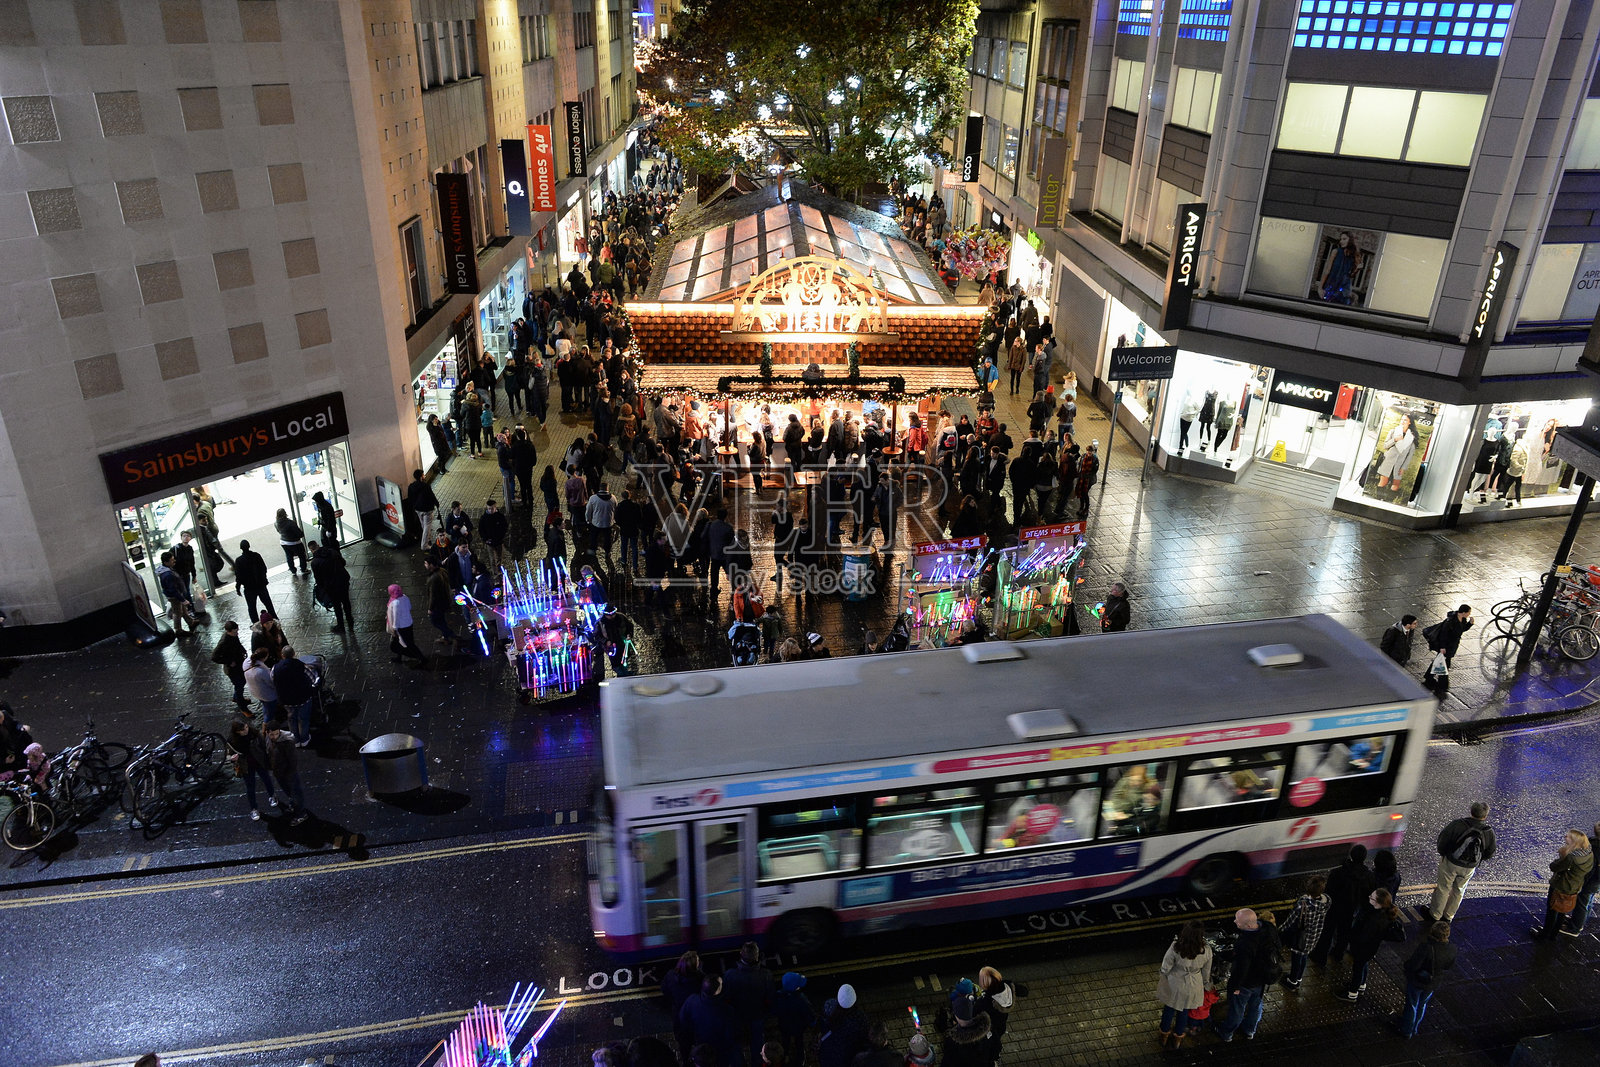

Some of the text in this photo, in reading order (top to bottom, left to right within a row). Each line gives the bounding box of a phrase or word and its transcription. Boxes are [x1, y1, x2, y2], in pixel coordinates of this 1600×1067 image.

[571, 105, 583, 175] vision express
[537, 158, 553, 208] phones
[963, 155, 973, 182] ecco
[1040, 174, 1061, 225] hotter
[449, 181, 462, 253] Sainsbury's
[1177, 210, 1200, 287] APRICOT
[455, 253, 470, 288] Local
[1475, 251, 1504, 338] APRICOT
[1117, 354, 1172, 365] Welcome
[1275, 381, 1333, 402] APRICOT
[123, 426, 270, 484] Sainsbury's
[271, 406, 335, 442] Local
[919, 543, 946, 553] ITEMS
[961, 537, 982, 548] £1
[1024, 529, 1049, 539] ITEMS
[1063, 523, 1081, 535] £1
[1049, 745, 1104, 761] bus
[1106, 735, 1192, 755] driver
[1002, 909, 1096, 935] LOOK
[559, 966, 659, 996] LOOK
